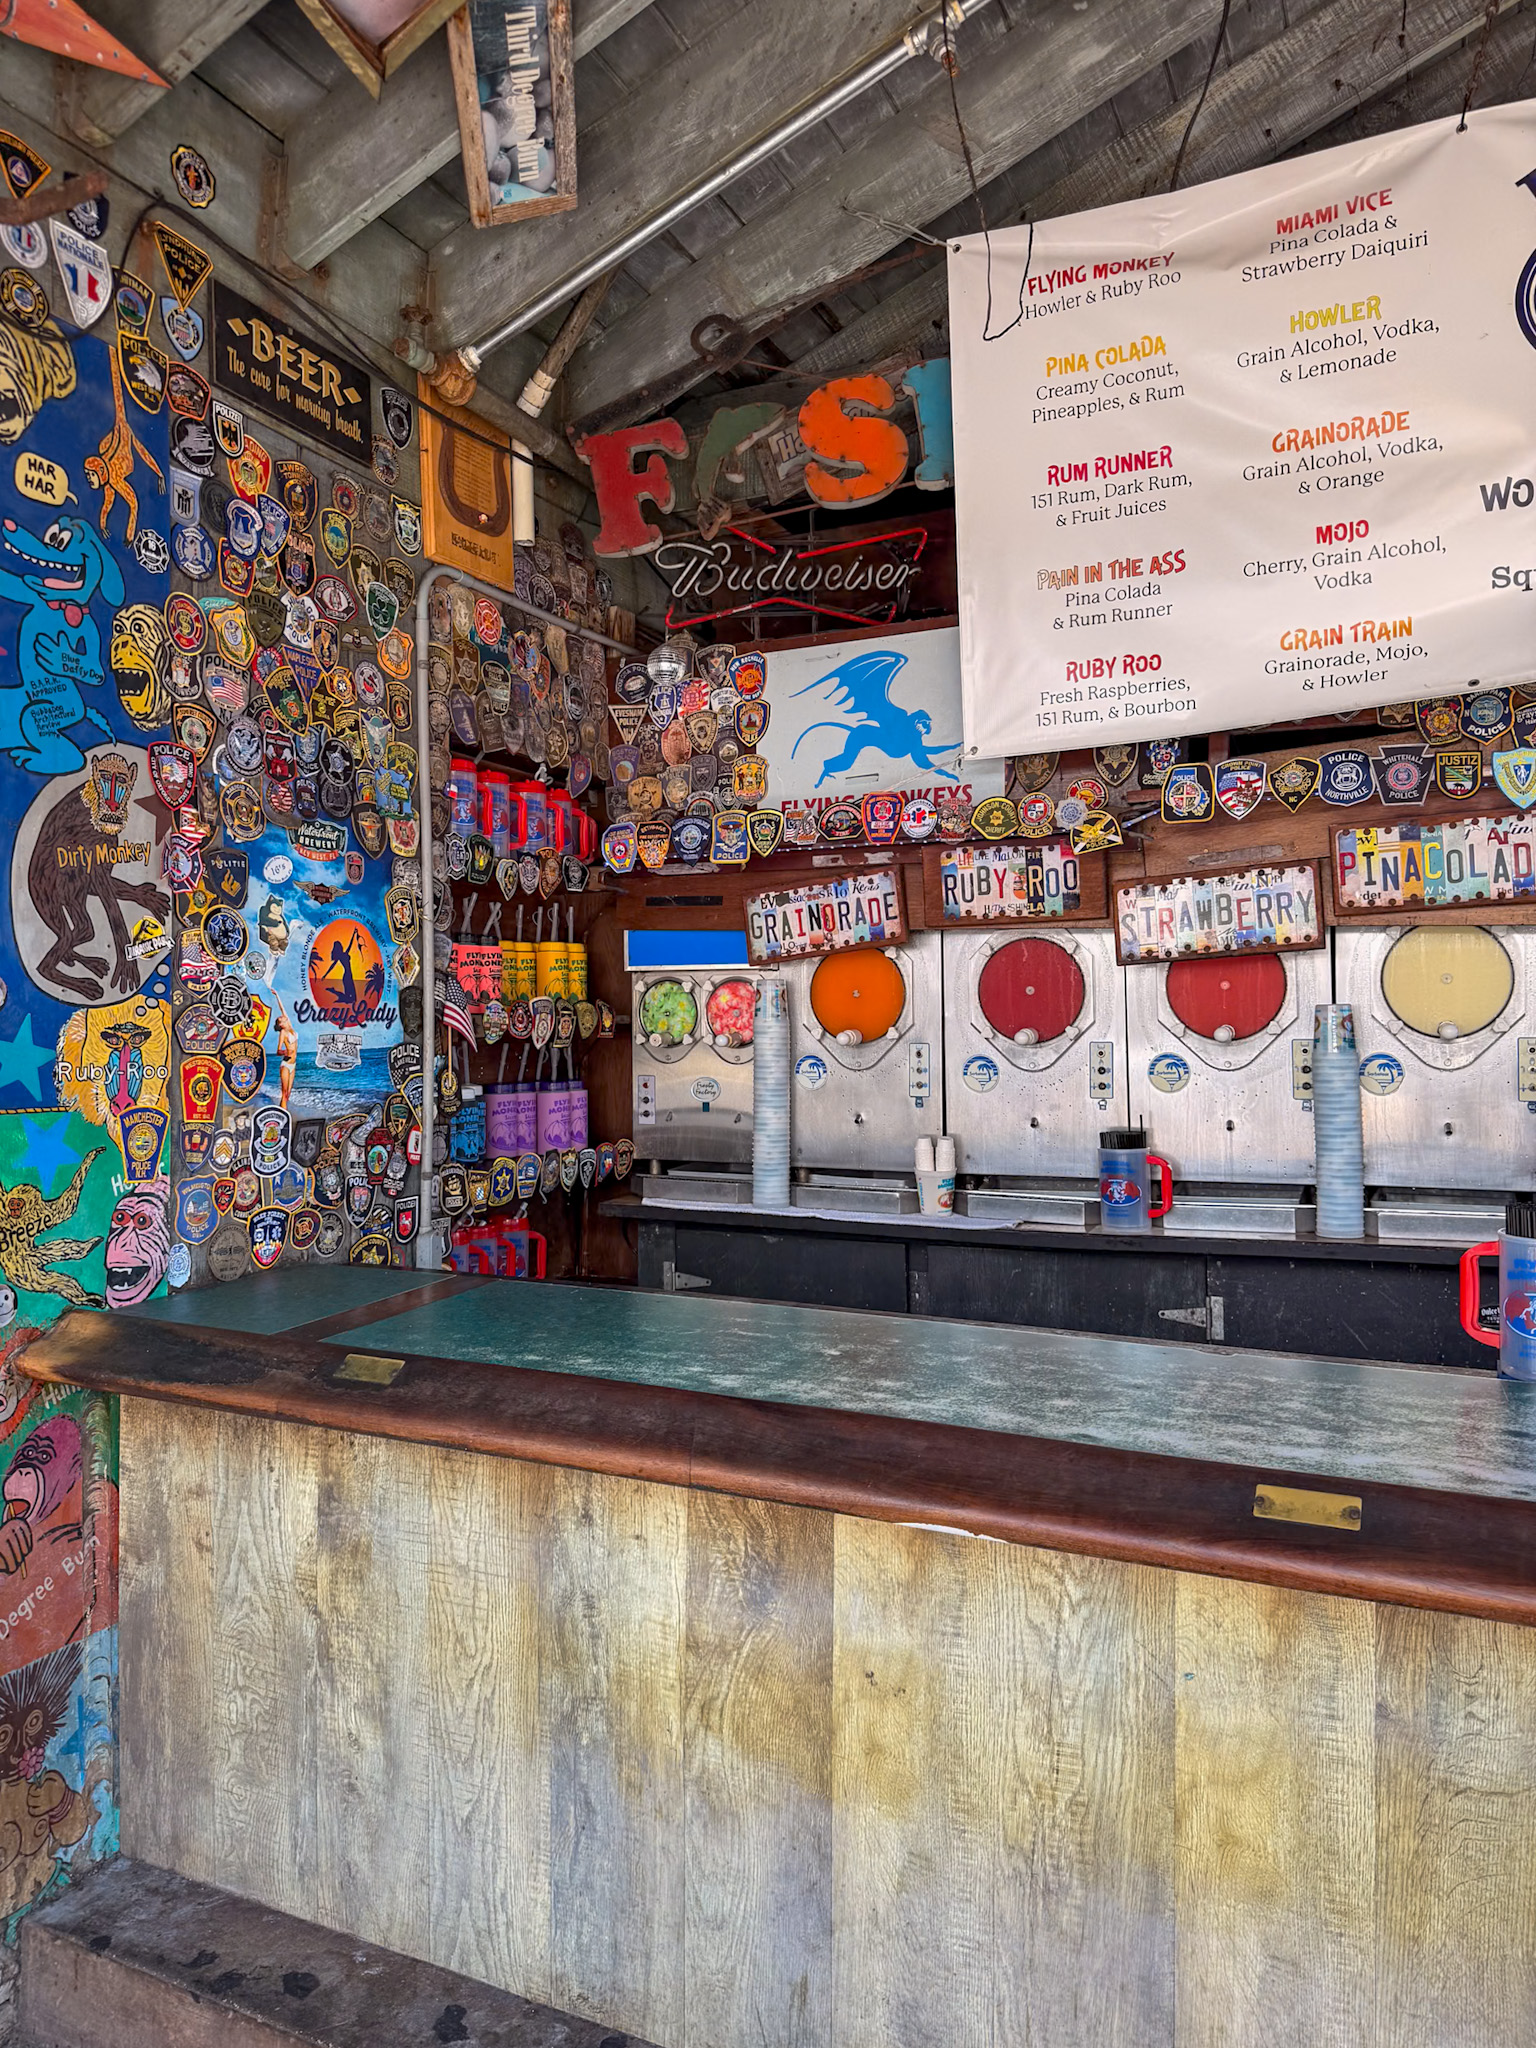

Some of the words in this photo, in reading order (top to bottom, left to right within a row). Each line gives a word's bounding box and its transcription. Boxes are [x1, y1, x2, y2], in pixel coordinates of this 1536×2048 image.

[505, 6, 539, 66] Third
[507, 67, 540, 136] Degree
[517, 137, 545, 182] Burn
[68, 212, 100, 237] POLICE
[1277, 204, 1338, 235] MIAMI
[1346, 188, 1392, 215] VICE
[59, 233, 100, 258] POLICE
[1270, 237, 1308, 254] Pina
[1314, 218, 1378, 244] Colada
[1385, 215, 1397, 229] &
[57, 239, 104, 270] NATIONALE
[164, 243, 201, 273] POLICE
[1242, 250, 1346, 282] Strawberry
[1351, 230, 1428, 260] Daiquiri
[1028, 264, 1086, 296] FLYING
[1093, 252, 1175, 280] MONKEY
[1025, 295, 1081, 319] Howler
[1086, 290, 1096, 304] &
[1101, 280, 1143, 301] Ruby
[1148, 272, 1181, 289] Roo
[1290, 296, 1382, 333] HOWLER
[122, 338, 167, 368] POLICE
[1236, 348, 1285, 367] Grain
[1290, 329, 1367, 357] Alcohol,
[1373, 318, 1440, 340] Vodka,
[248, 319, 344, 406] BEER
[1046, 353, 1089, 377] PINA
[1095, 335, 1166, 369] COLADA
[1279, 369, 1292, 383] &
[1298, 347, 1396, 380] Lemonade
[227, 346, 245, 376] The
[250, 366, 271, 392] cure
[276, 374, 290, 402] for
[296, 391, 330, 430] morning
[1037, 379, 1098, 400] Creamy
[1103, 362, 1178, 387] Coconut,
[215, 406, 242, 424] POLIZEI
[1032, 397, 1124, 423] Pineapples,
[1129, 392, 1140, 405] &
[1146, 385, 1185, 402] Rum
[1272, 411, 1410, 454] GRAINORADE
[28, 458, 56, 480] HAR
[1048, 463, 1088, 487] RUM
[1094, 445, 1173, 479] RUNNER
[1242, 461, 1291, 481] Grain
[1296, 446, 1372, 473] Alcohol,
[1377, 437, 1443, 458] Vodka,
[25, 476, 55, 499] HAR
[1031, 493, 1053, 509] 151
[1058, 490, 1099, 505] Rum,
[1105, 479, 1144, 498] Dark
[1149, 475, 1192, 491] Rum,
[1299, 481, 1310, 494] &
[1316, 471, 1384, 491] Orange
[1056, 514, 1067, 527] &
[1072, 506, 1111, 525] Fruit
[1115, 500, 1166, 518] Juices
[1316, 520, 1369, 545] MOJO
[1037, 565, 1079, 590] PAIN
[1085, 562, 1102, 584] IN
[1108, 558, 1143, 580] THE
[1149, 549, 1186, 576] ASS
[1243, 558, 1307, 577] Cherry,
[1312, 548, 1362, 567] Grain
[1367, 536, 1446, 560] Alcohol,
[655, 543, 922, 598] Budweiser
[1314, 571, 1372, 590] Vodka
[1492, 566, 1536, 592] Sq
[1066, 592, 1100, 607] Pina
[1105, 582, 1161, 602] Colada
[1053, 618, 1064, 630] &
[1069, 614, 1107, 628] Rum
[1112, 604, 1173, 622] Runner
[287, 624, 311, 646] POLICE
[1280, 624, 1343, 651] GRAIN
[1350, 616, 1412, 646] TRAIN
[62, 653, 81, 664] Blue
[1066, 656, 1117, 683] RUBY
[1123, 654, 1162, 676] ROO
[1265, 651, 1370, 674] Grainorade,
[1376, 644, 1428, 661] Mojo,
[32, 684, 67, 698] APPROVED
[1041, 688, 1083, 705] Fresh
[1088, 677, 1190, 700] Raspberries,
[1302, 679, 1314, 691] &
[1320, 670, 1388, 688] Howler
[615, 709, 642, 717] EVESHAM
[619, 718, 639, 726] POLICE
[1036, 712, 1056, 727] 151
[1062, 710, 1104, 724] Rum,
[1107, 706, 1119, 720] &
[1124, 698, 1196, 718] Bourbon
[1467, 723, 1507, 736] POLICE
[153, 745, 190, 760] POLICE
[1328, 753, 1365, 764] POLICE
[1382, 754, 1423, 765] WHITEHALL
[1440, 755, 1478, 765] JUSTIZ
[1325, 784, 1369, 800] NORTHVILLE
[1389, 790, 1419, 799] POLICE
[977, 802, 999, 821] JOHNSON
[1001, 802, 1016, 824] COUNTY
[298, 823, 339, 840] Waterfront
[299, 836, 337, 848] BREWERY
[1021, 826, 1049, 835] POLICE
[57, 846, 93, 874] Dirty
[96, 840, 151, 866] Monkey
[717, 852, 744, 860] POLICE
[944, 866, 1008, 907] RUBY
[1028, 859, 1079, 898] ROO
[749, 891, 898, 944] GRAINORADE
[1121, 889, 1314, 943] STRAWBERRY
[301, 930, 315, 960] BLONDE
[179, 967, 220, 977] POLICE
[186, 1040, 216, 1050] POLICE
[391, 1044, 420, 1063] POLICE
[57, 1062, 168, 1085] Ruby-Roo
[123, 1114, 165, 1128] MANCHESTER
[132, 1161, 151, 1170] POLICE
[258, 1161, 282, 1171] POLICE
[313, 1157, 340, 1171] POLICE
[186, 1223, 210, 1233] POLICE
[0, 1576, 54, 1640] Degree
[61, 1535, 101, 1576] Burn
